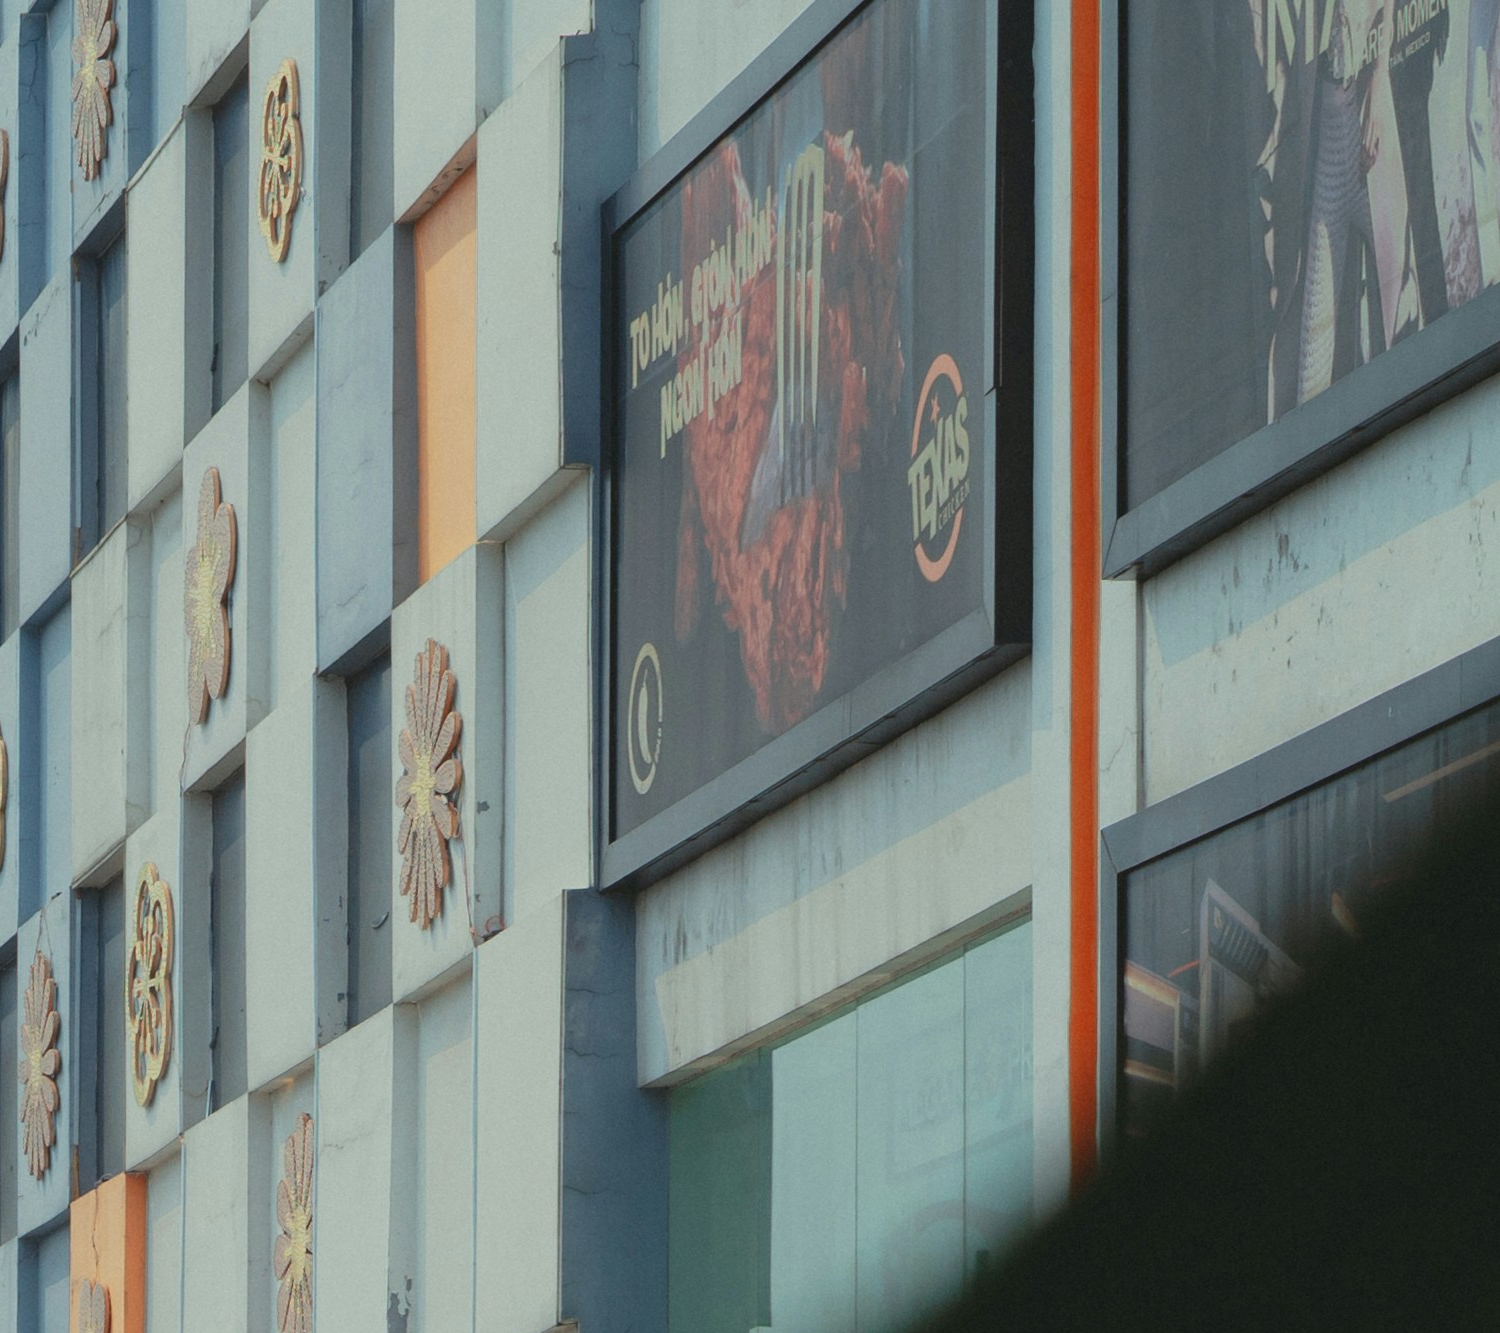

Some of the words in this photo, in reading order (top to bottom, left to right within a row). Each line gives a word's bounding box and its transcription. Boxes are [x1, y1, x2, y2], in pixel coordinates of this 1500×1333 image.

[631, 311, 650, 389] TO
[661, 351, 706, 459] NGON
[908, 396, 970, 541] TEXAS
[938, 479, 971, 531] CHICKEN
